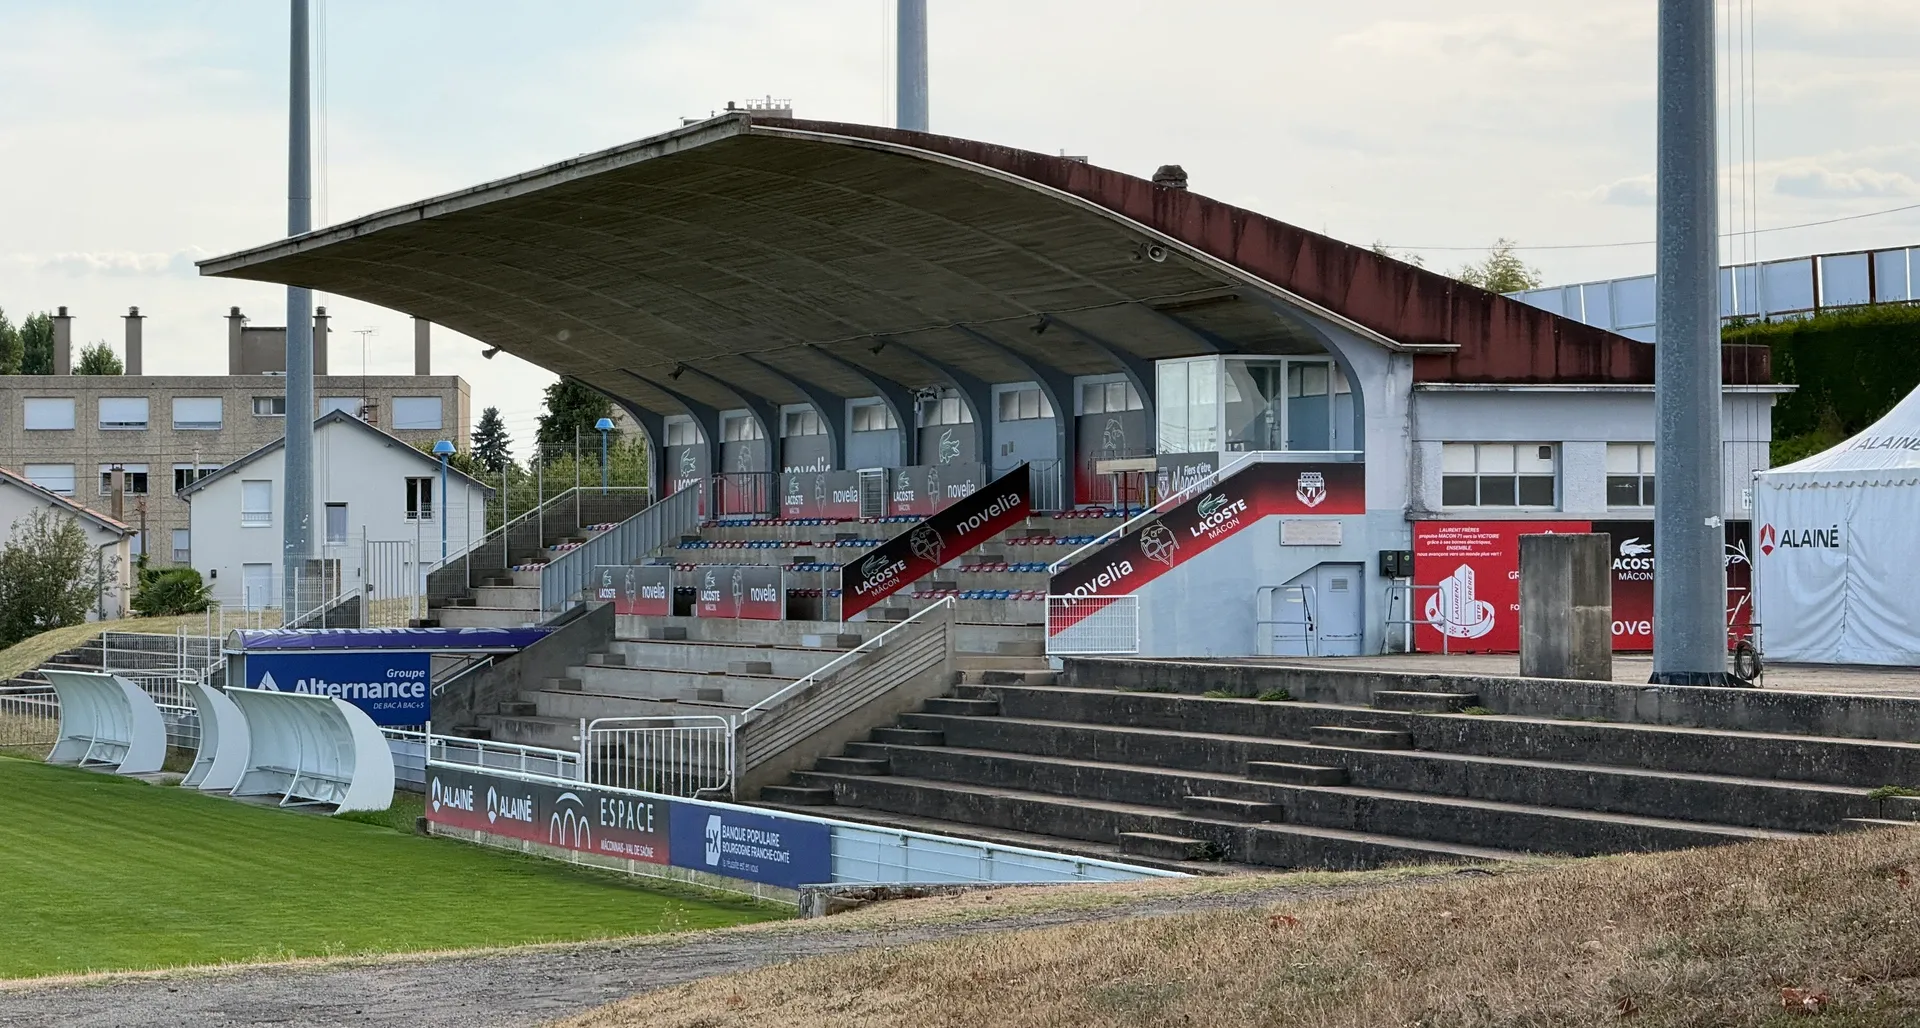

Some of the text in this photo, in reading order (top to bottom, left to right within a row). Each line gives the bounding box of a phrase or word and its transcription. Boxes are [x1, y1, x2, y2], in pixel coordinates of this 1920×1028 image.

[833, 486, 858, 504] novelia
[894, 491, 914, 501] LACOSTE
[947, 479, 975, 498] novelia
[956, 492, 1021, 536] novelia
[1190, 499, 1247, 538] LACOSTE
[1208, 517, 1240, 540] MÂCON
[1780, 524, 1839, 548] ALAINÉ
[1612, 557, 1654, 570] ACOST
[854, 560, 907, 596] LACOSTE
[1063, 560, 1133, 609] novelia
[1618, 572, 1653, 580] MÂCON
[642, 582, 666, 599] novelia
[701, 590, 720, 601] LACOSTE
[750, 584, 776, 602] novelia
[870, 577, 900, 597] MÂCON
[1611, 617, 1654, 635] ovel
[386, 668, 425, 680] Groupe
[294, 678, 425, 699] Alternance
[443, 785, 474, 812] ALAINÉ
[500, 795, 532, 822] ALAINÉ
[600, 798, 654, 833] ESPACE
[722, 825, 780, 847] BANQUE POPULAIRE
[722, 841, 790, 864] BOURGOGNE FRANCHE-COMTÉ
